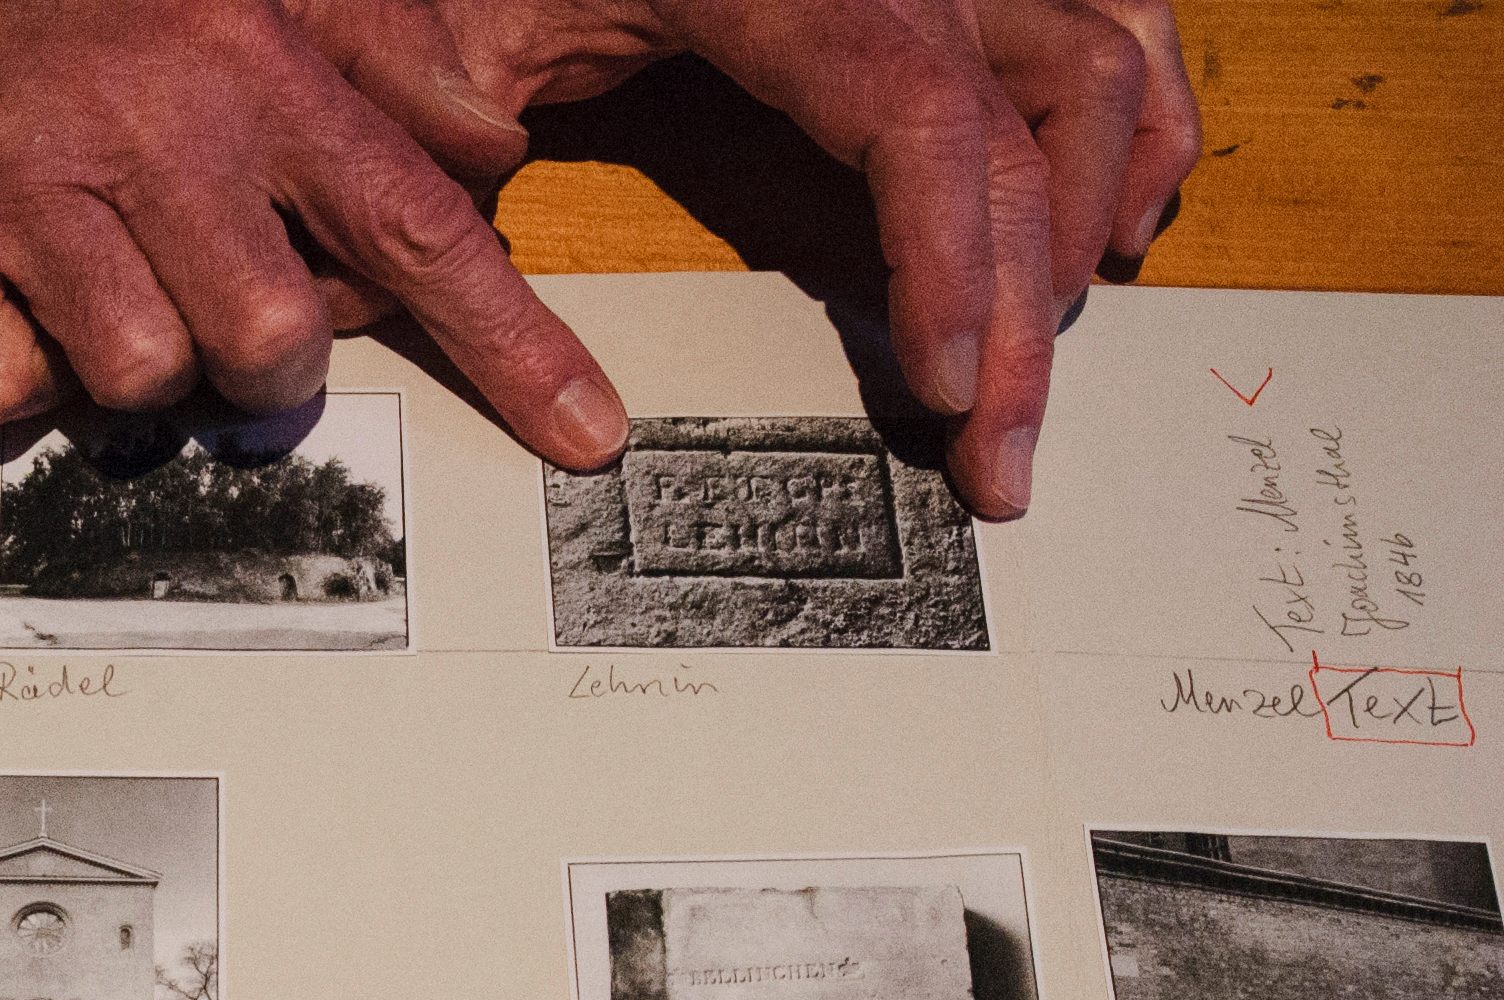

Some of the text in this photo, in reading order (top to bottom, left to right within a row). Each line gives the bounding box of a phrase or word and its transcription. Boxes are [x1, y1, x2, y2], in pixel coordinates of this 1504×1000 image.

[1227, 434, 1299, 533] Menzel
[568, 663, 720, 699] Lehnin
[1160, 666, 1460, 729] Menzel Text
